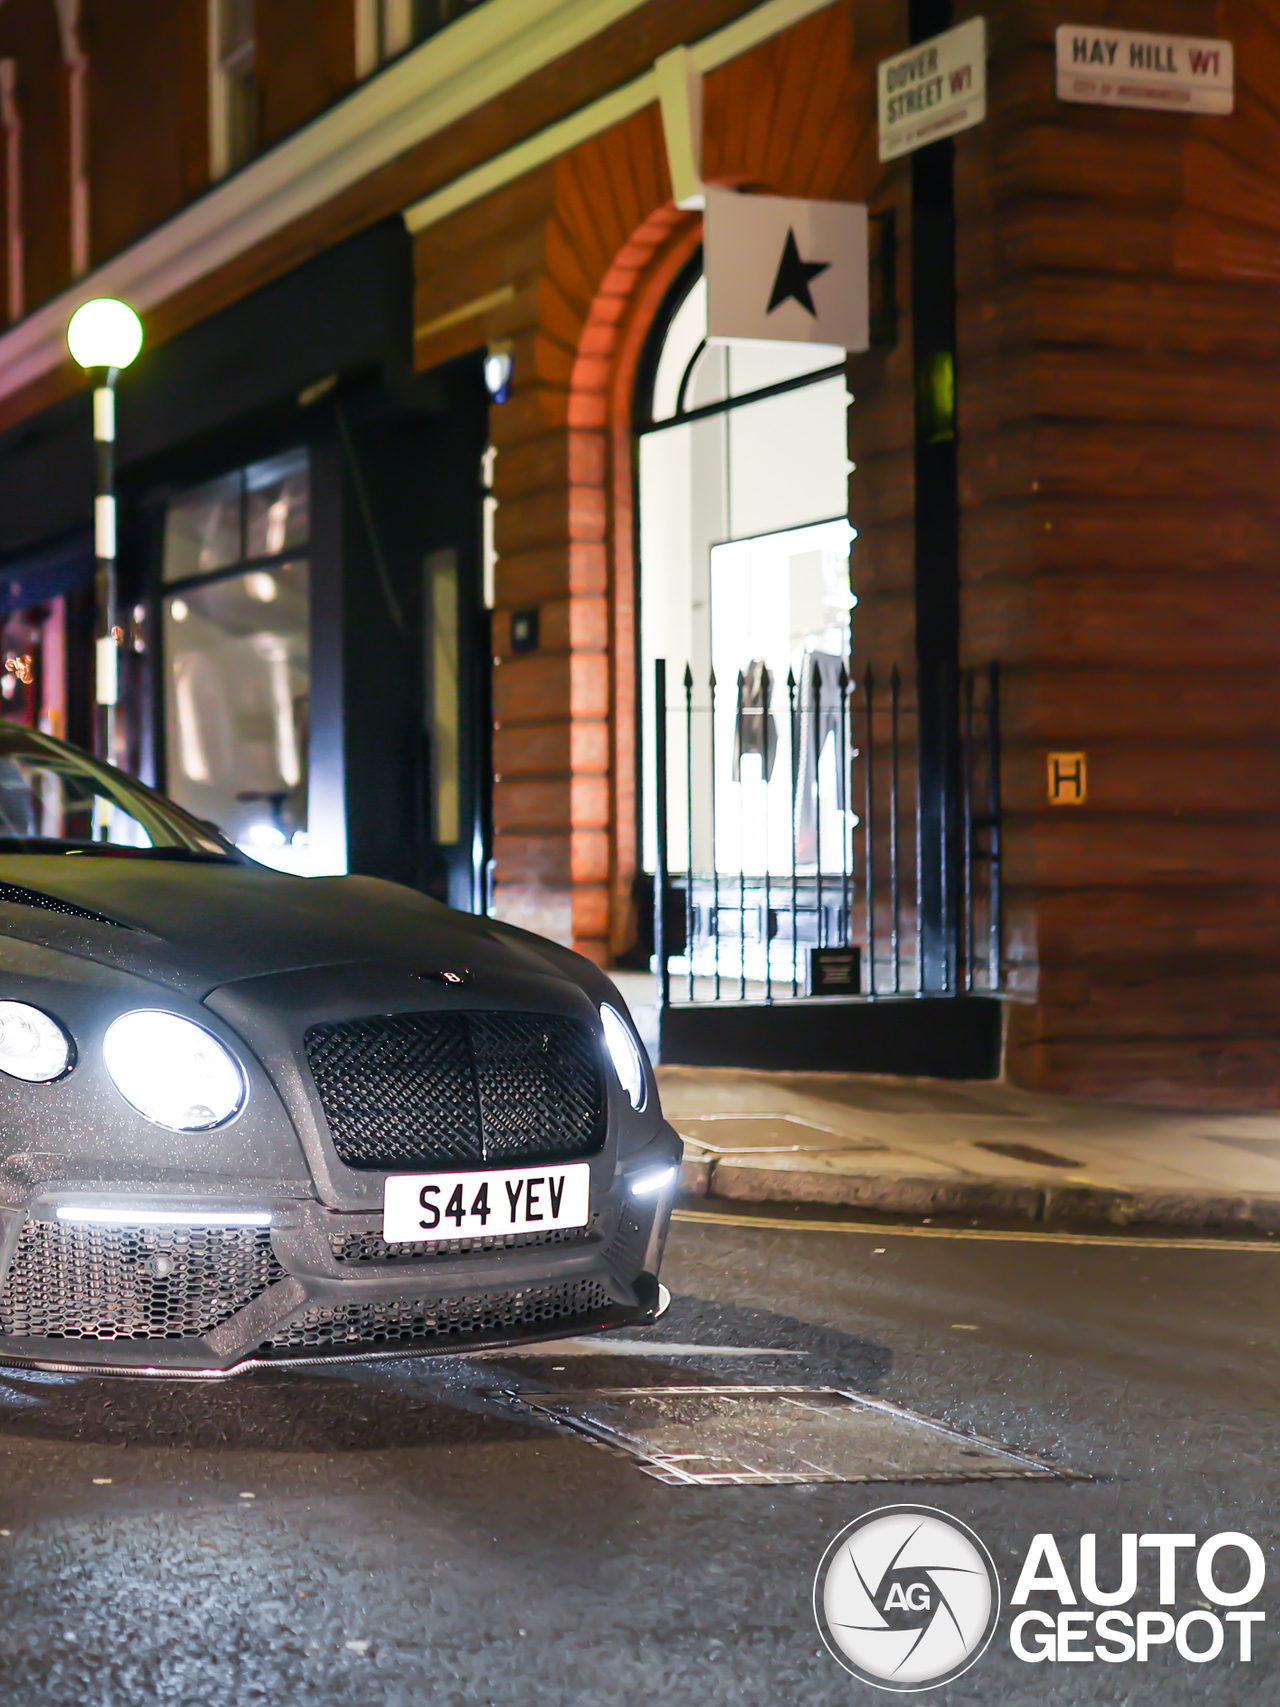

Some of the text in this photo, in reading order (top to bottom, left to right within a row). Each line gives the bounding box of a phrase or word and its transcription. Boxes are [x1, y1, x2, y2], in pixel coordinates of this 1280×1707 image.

[886, 47, 938, 94] DOVER
[1073, 37, 1219, 76] HAY HILL W1
[887, 63, 972, 124] STREET W1
[1055, 759, 1081, 797] H
[419, 1176, 565, 1229] S44 YEV
